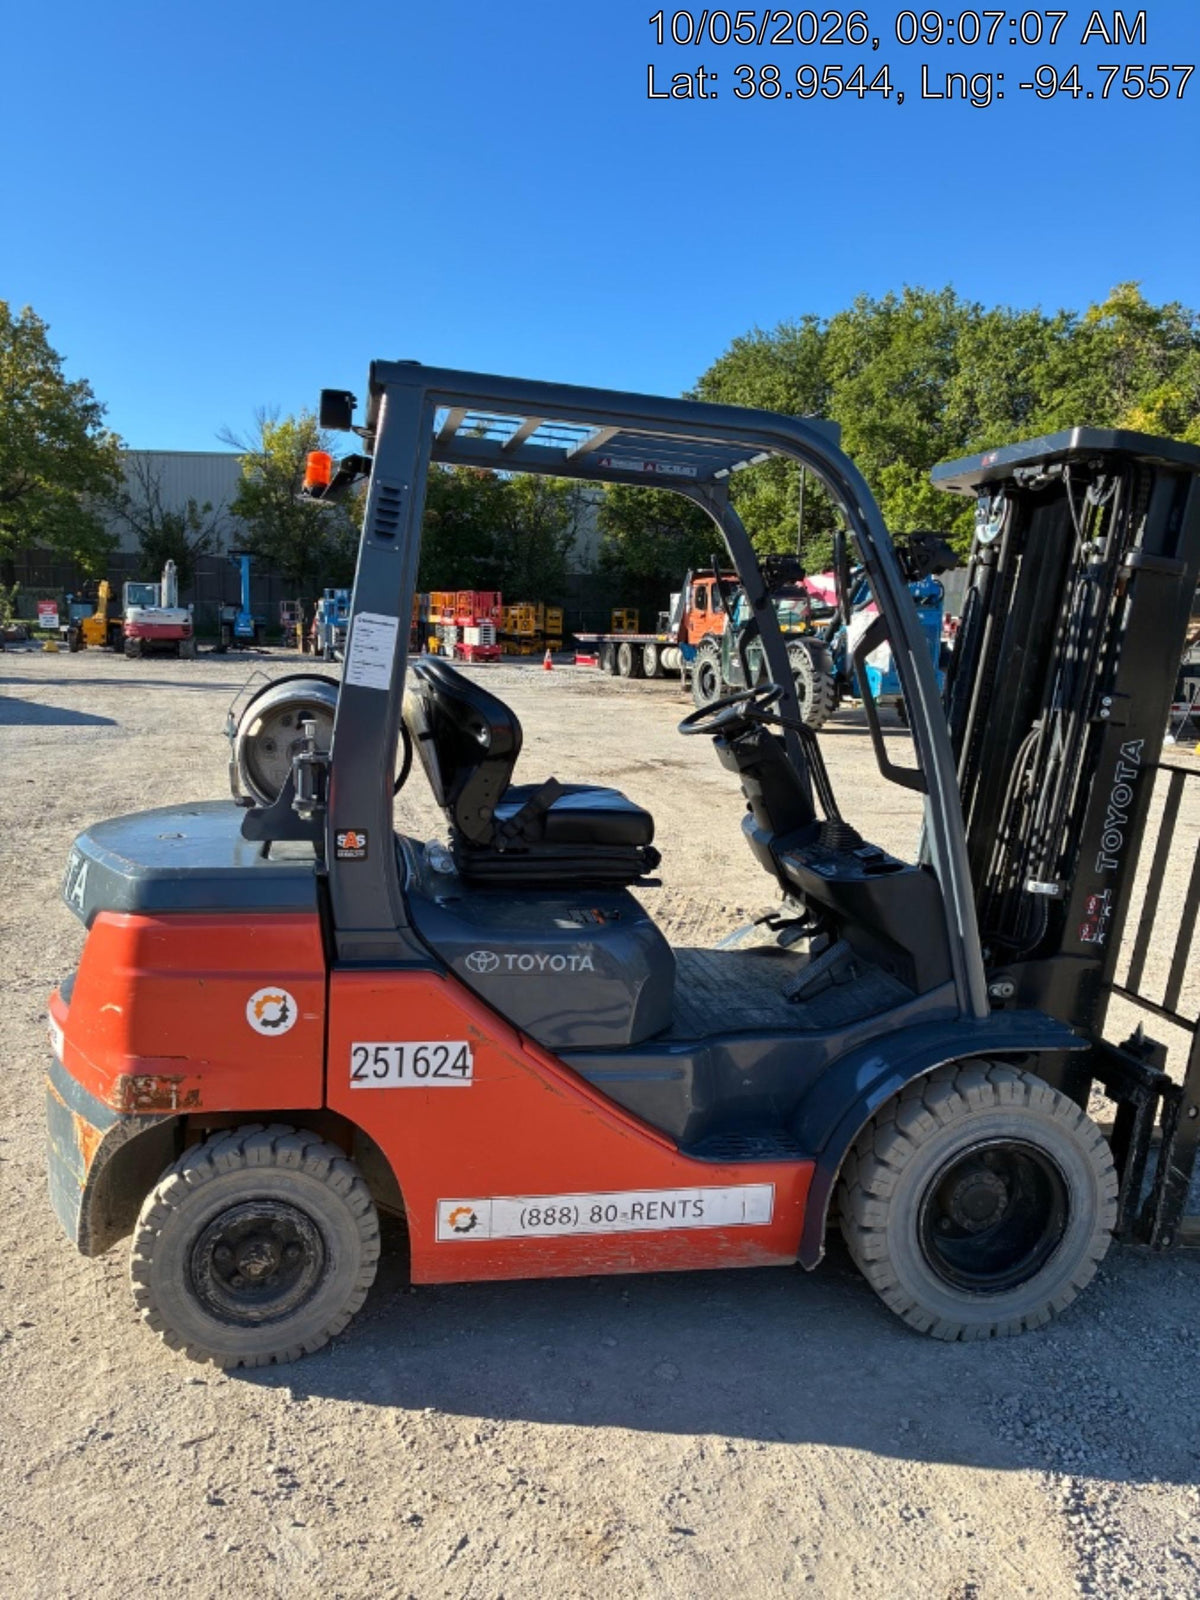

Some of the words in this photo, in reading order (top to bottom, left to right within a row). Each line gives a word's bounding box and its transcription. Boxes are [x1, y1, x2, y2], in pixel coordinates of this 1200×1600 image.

[1095, 738, 1145, 873] TOYOTA
[504, 953, 594, 972] TOYOTA
[352, 1045, 470, 1078] 251624
[520, 1205, 579, 1229] (888)
